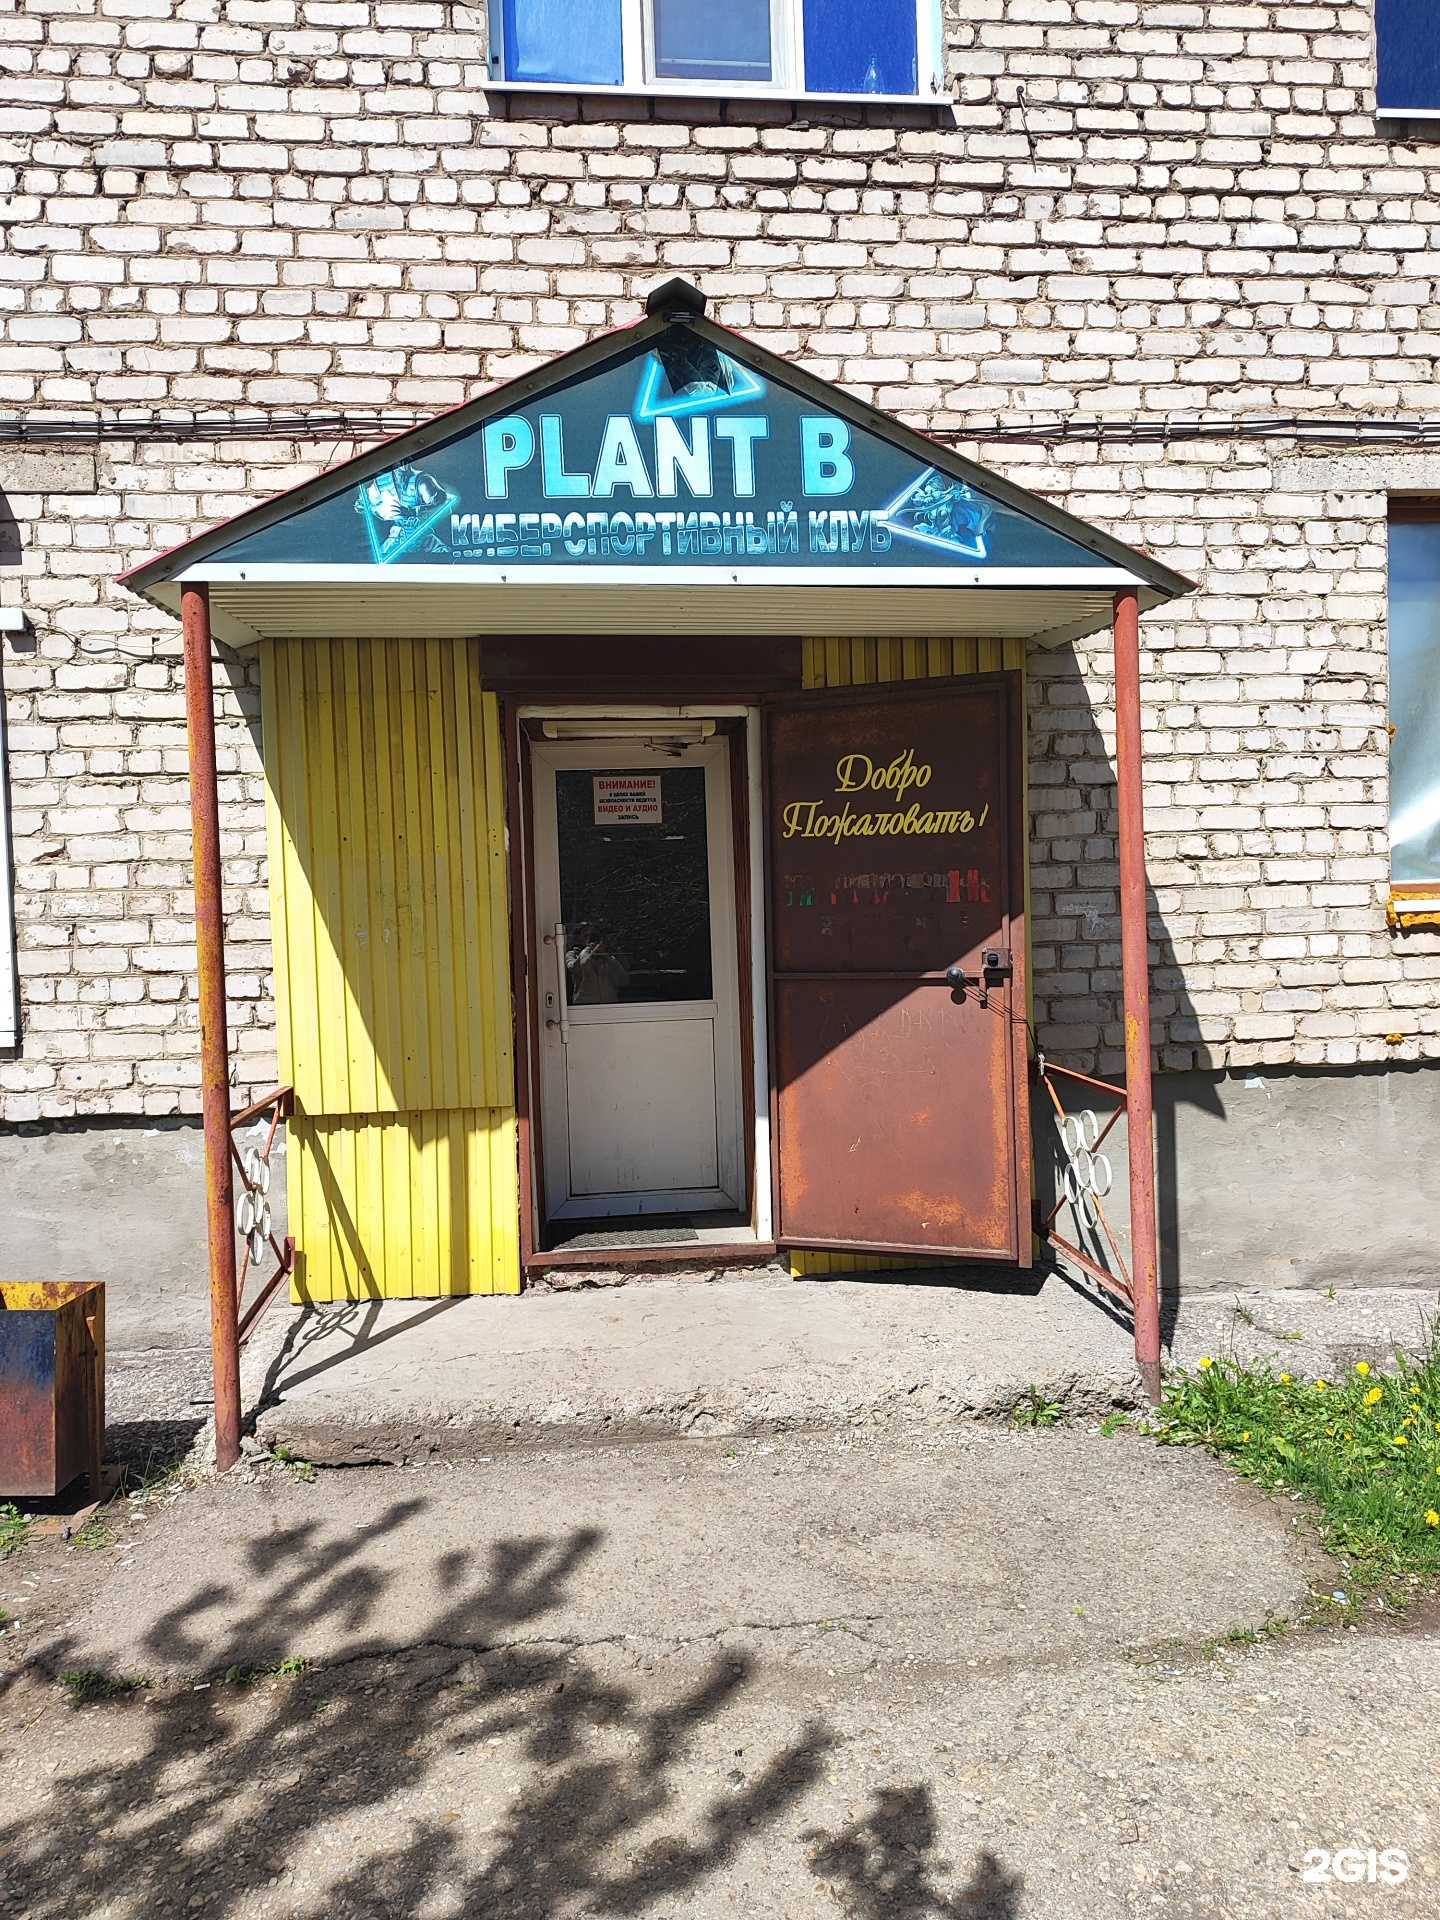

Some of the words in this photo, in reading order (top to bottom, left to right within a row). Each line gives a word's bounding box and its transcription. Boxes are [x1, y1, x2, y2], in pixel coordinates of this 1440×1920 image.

[482, 414, 769, 500] PLANT
[800, 414, 855, 497] B
[451, 500, 799, 557] КИБЕРСПОРТИВНЫЙ
[808, 510, 892, 553] КЛУБ
[598, 780, 656, 790] ВНИМАНИЕ!
[834, 748, 932, 802] Добро
[625, 805, 631, 813] И
[632, 804, 658, 813] АУДИО
[782, 800, 990, 845] Пожаловать!
